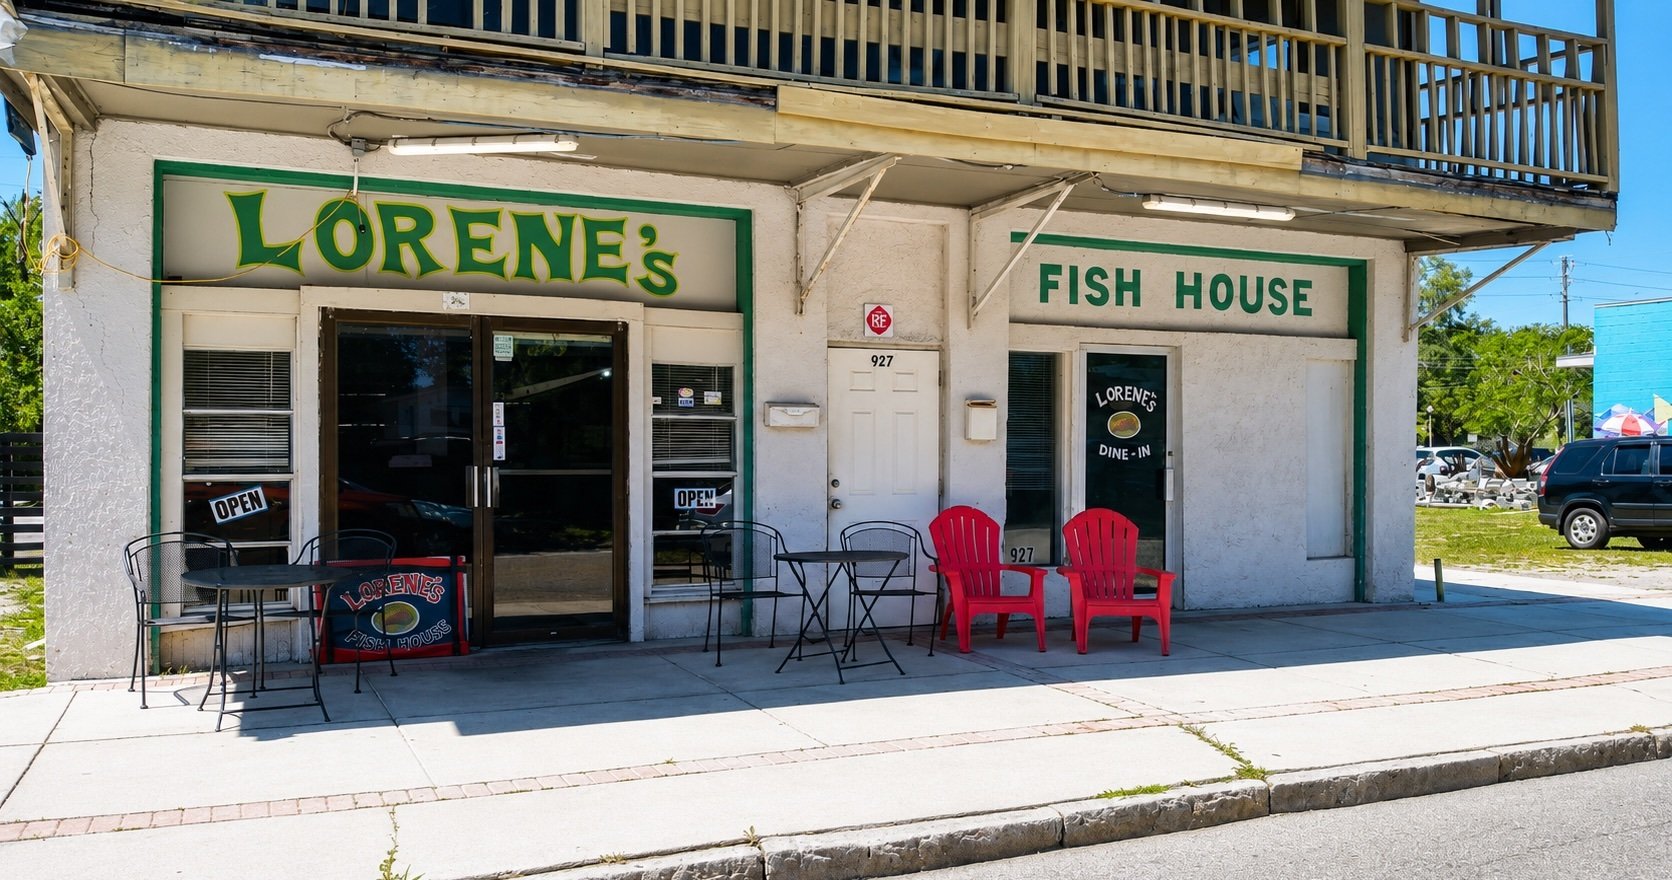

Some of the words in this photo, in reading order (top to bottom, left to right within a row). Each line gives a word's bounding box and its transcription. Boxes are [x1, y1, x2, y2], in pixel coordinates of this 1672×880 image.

[1039, 263, 1142, 308] FISH
[1175, 271, 1313, 317] HOUSE
[871, 355, 894, 367] 927
[1095, 385, 1157, 413] LORENE'S
[214, 490, 263, 520] OPEN
[677, 490, 714, 507] OPEN
[1010, 547, 1034, 563] 927
[340, 573, 445, 611] LORENE'S
[344, 629, 391, 653] FISH
[397, 619, 452, 651] HOUSE
